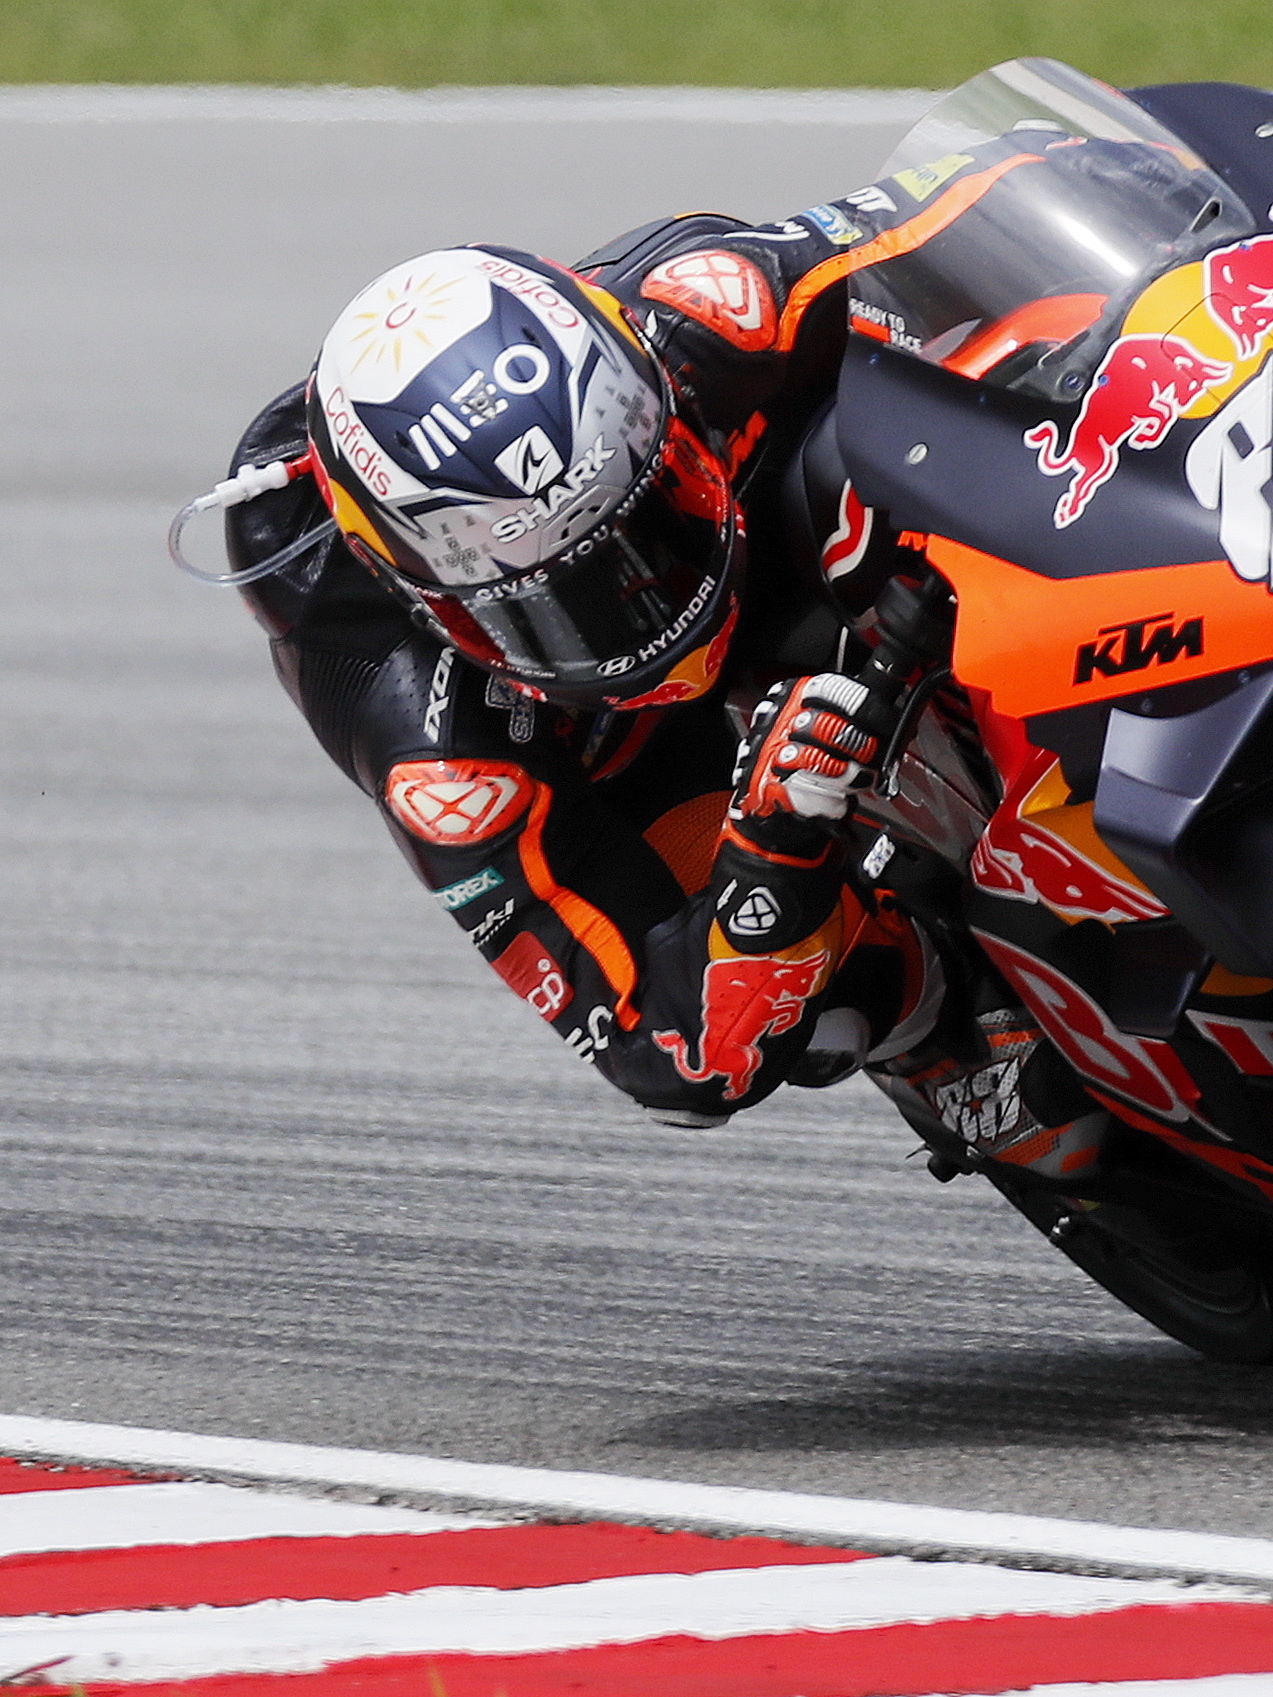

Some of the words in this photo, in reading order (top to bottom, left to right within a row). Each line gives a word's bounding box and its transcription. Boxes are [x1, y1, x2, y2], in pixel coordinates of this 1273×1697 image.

[326, 386, 392, 496] Cofidis
[490, 432, 616, 544] SHARK
[474, 568, 549, 602] GIVES
[559, 524, 609, 566] YOU
[638, 574, 716, 662] HYUNDAI
[1072, 611, 1204, 686] KTM
